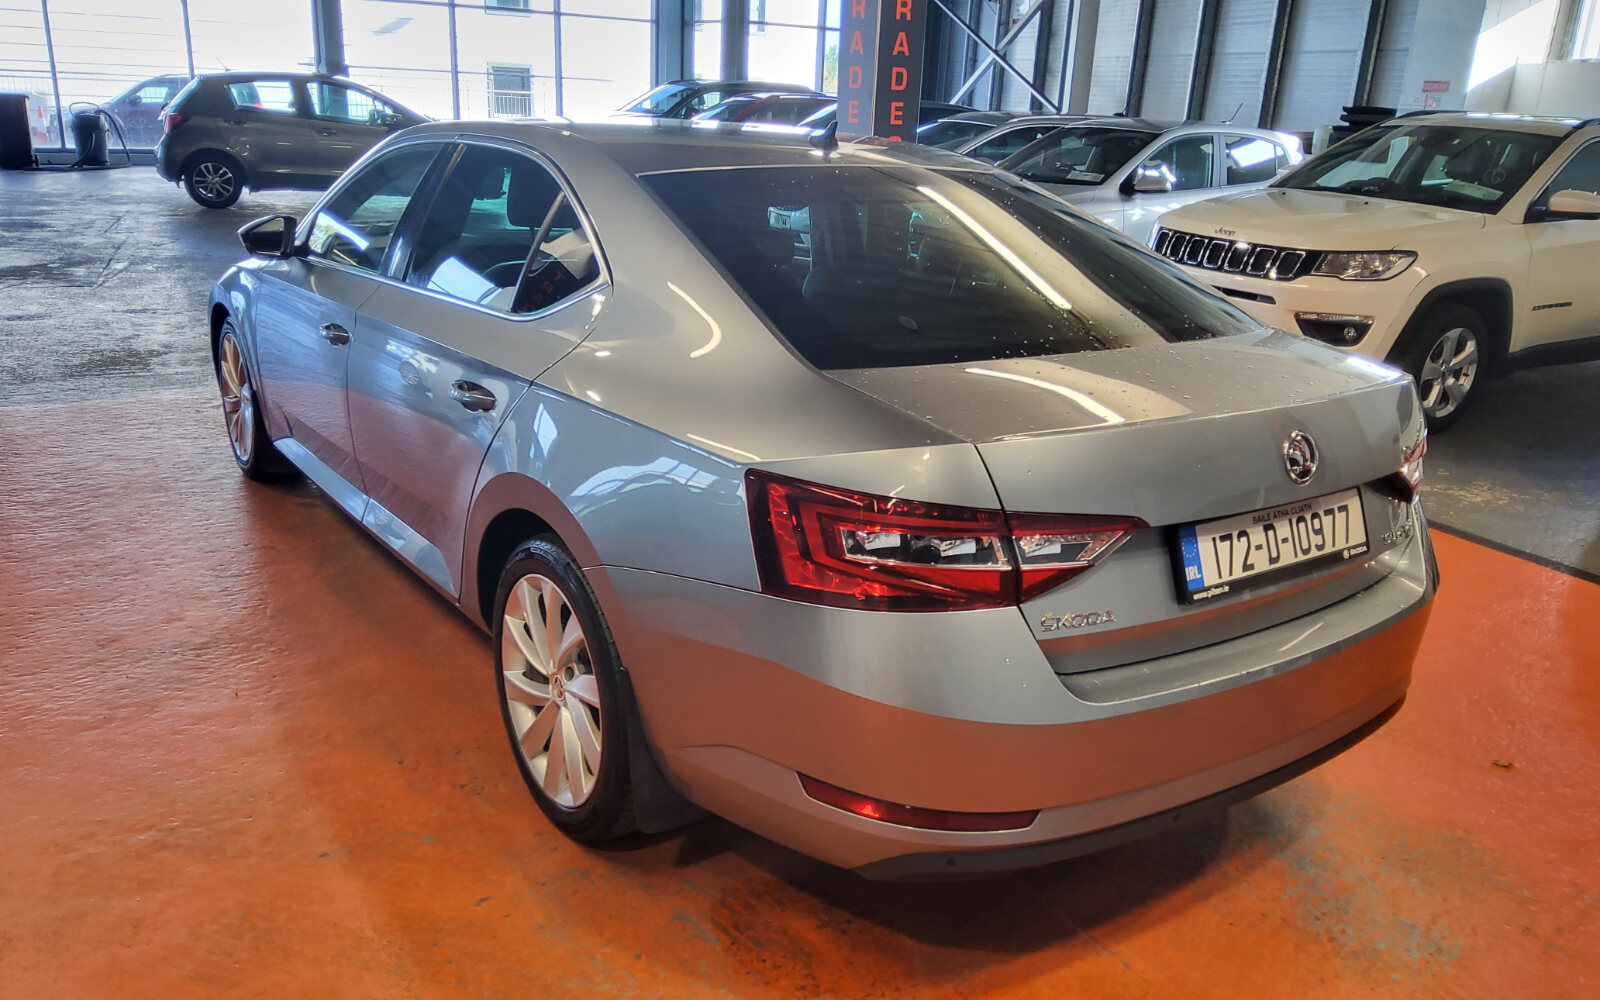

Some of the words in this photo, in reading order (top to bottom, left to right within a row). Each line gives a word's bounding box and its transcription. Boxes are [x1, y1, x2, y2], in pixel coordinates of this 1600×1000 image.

[889, 0, 913, 142] RADE
[1252, 512, 1272, 525] BAILE
[1290, 503, 1313, 515] CLIATH
[1212, 504, 1349, 580] 172-D-10977
[1185, 564, 1202, 581] IRL
